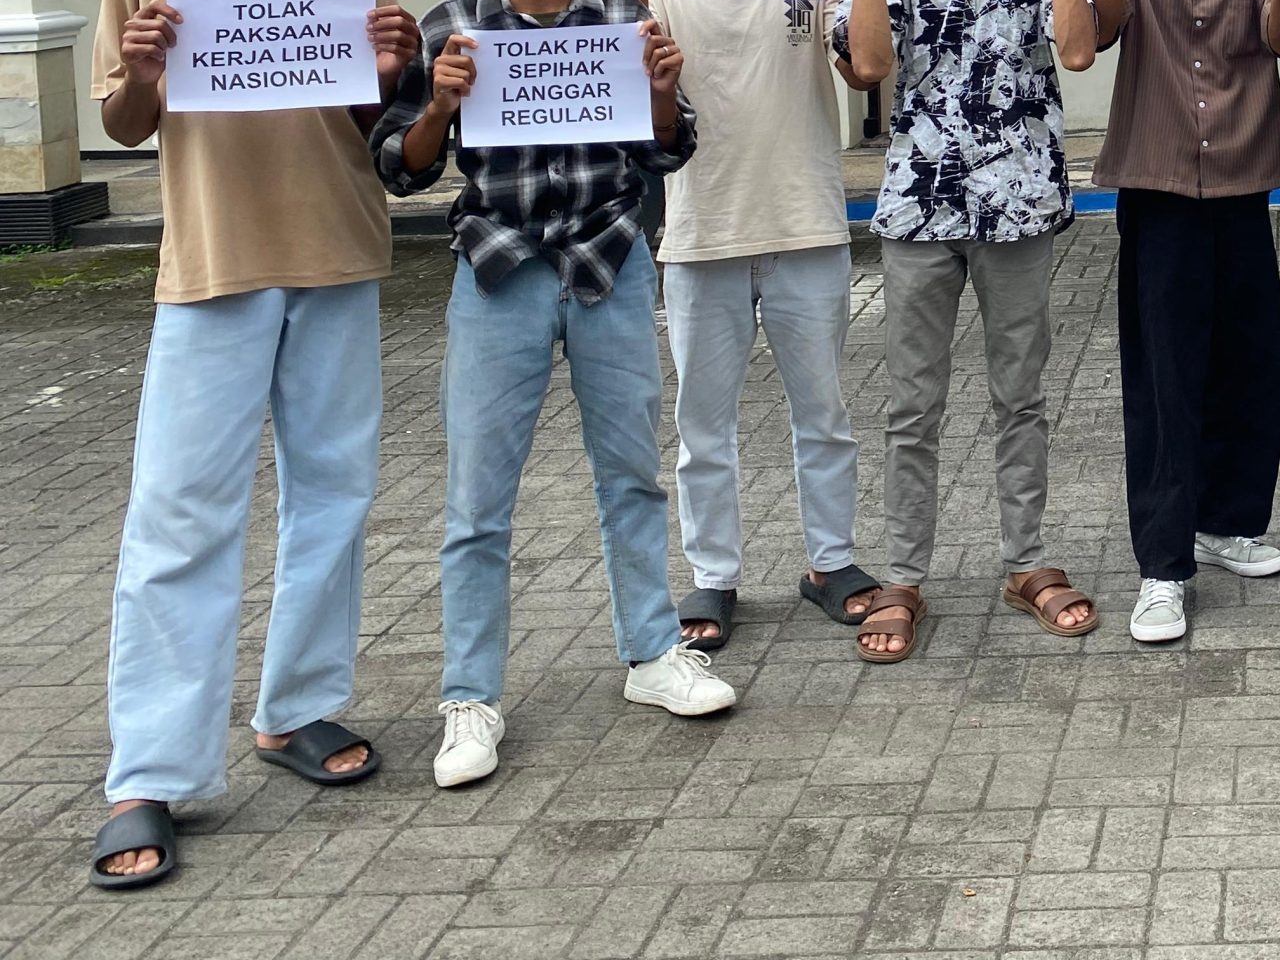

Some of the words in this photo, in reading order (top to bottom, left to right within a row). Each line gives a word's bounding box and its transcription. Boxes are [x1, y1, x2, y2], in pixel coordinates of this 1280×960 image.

[233, 0, 315, 20] TOLAK
[216, 23, 332, 43] PAKSAAN
[192, 49, 275, 68] KERJA
[282, 43, 352, 62] LIBUR
[494, 40, 568, 57] TOLAK
[576, 37, 620, 53] PHK
[509, 60, 604, 79] SEPIHAK
[211, 69, 337, 91] NASIONAL
[503, 83, 611, 102] LANGGAR
[502, 106, 612, 126] REGULASI
